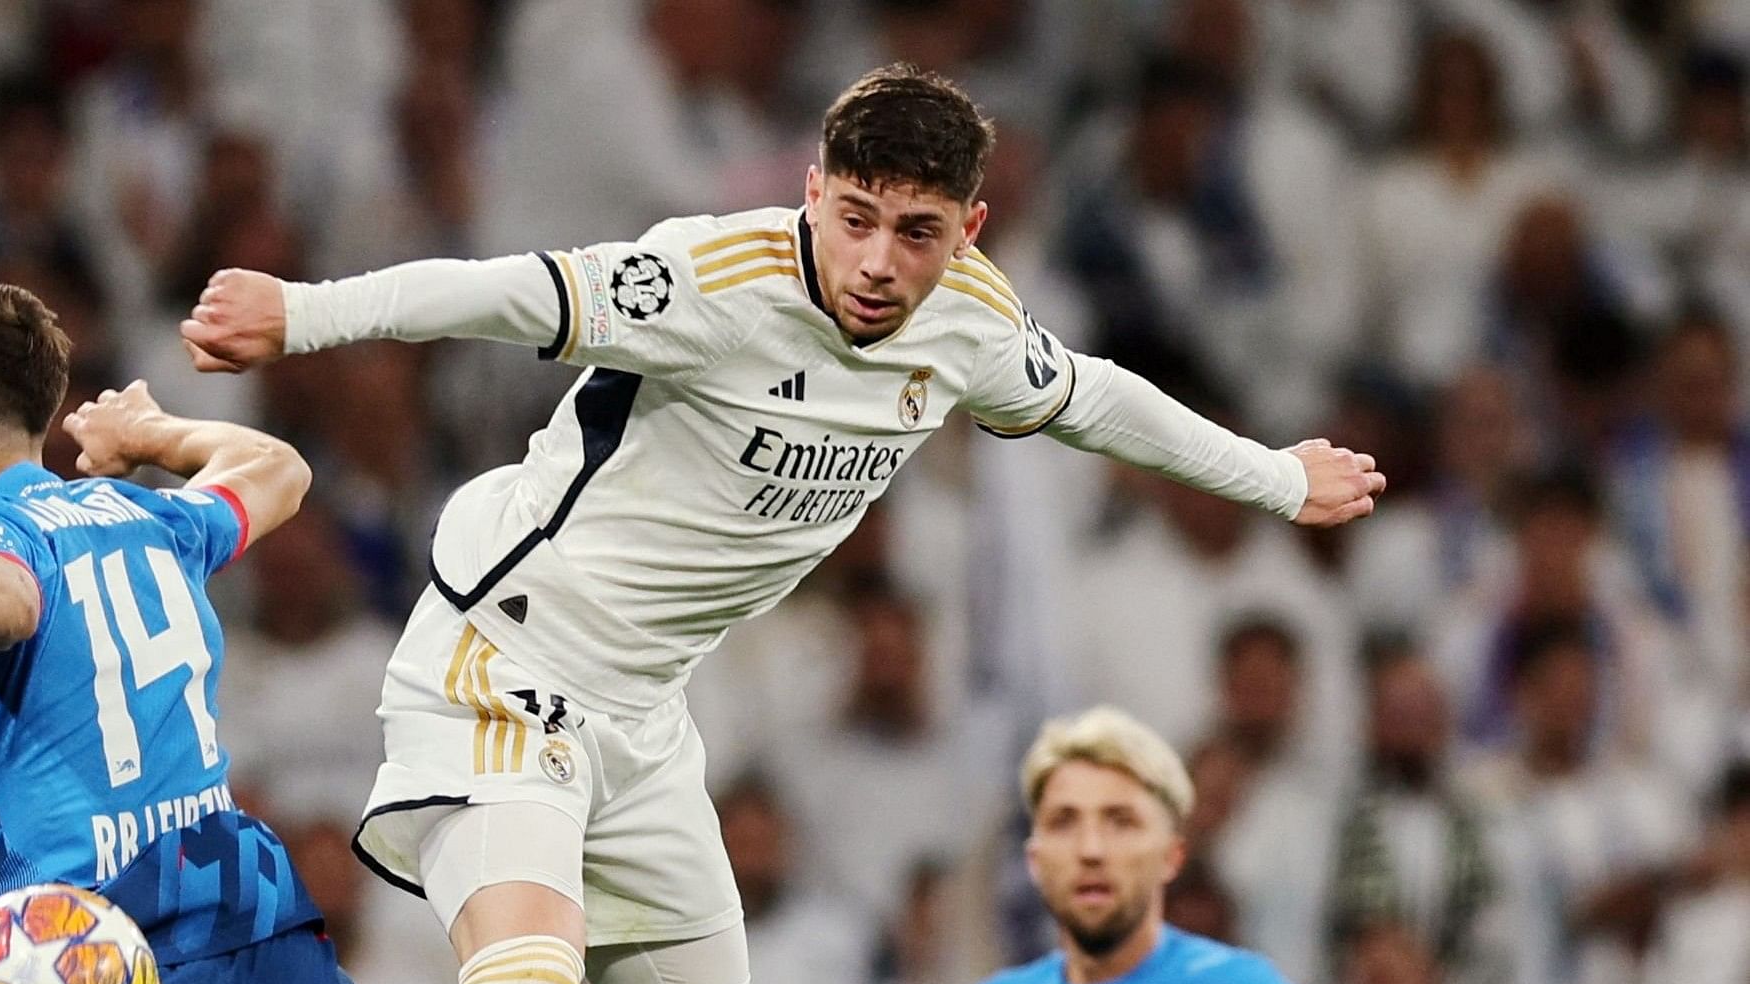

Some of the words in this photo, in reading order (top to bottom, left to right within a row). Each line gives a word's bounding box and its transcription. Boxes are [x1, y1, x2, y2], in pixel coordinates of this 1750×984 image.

[739, 425, 904, 481] Emirates
[744, 484, 799, 519] FLY
[789, 489, 866, 523] BETTER
[64, 546, 219, 788] 14
